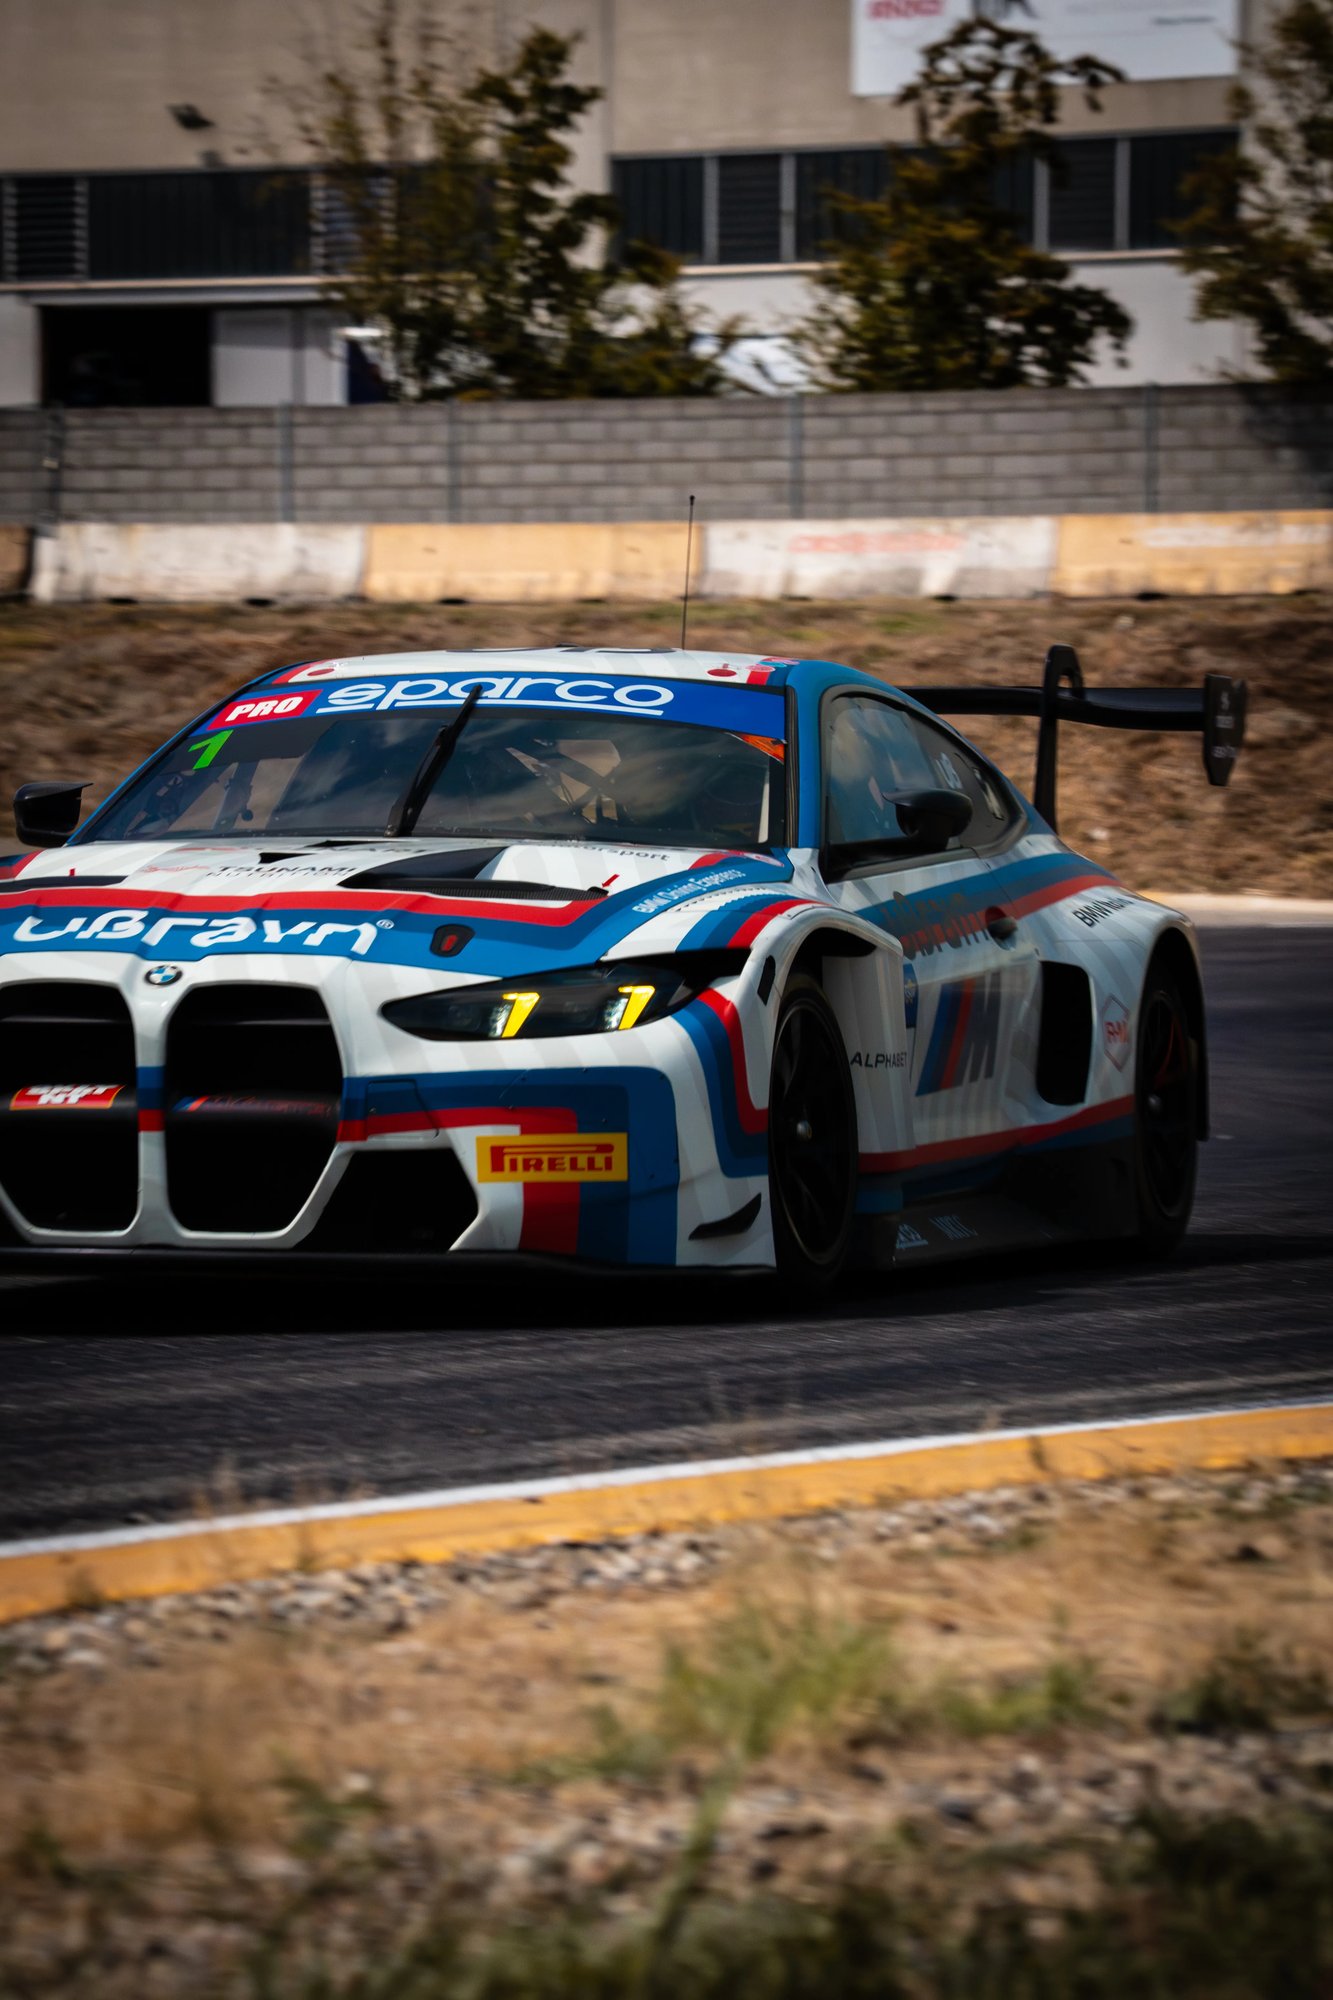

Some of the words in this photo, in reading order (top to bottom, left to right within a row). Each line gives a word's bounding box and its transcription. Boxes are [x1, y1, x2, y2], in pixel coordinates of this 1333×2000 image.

[326, 676, 675, 711] sparco
[224, 695, 305, 723] PRO
[187, 729, 234, 770] 1
[218, 865, 357, 873] TSUNAMI
[1072, 899, 1114, 929] BMW
[849, 1051, 908, 1069] ALPHABET
[489, 1143, 615, 1174] PIRELLI
